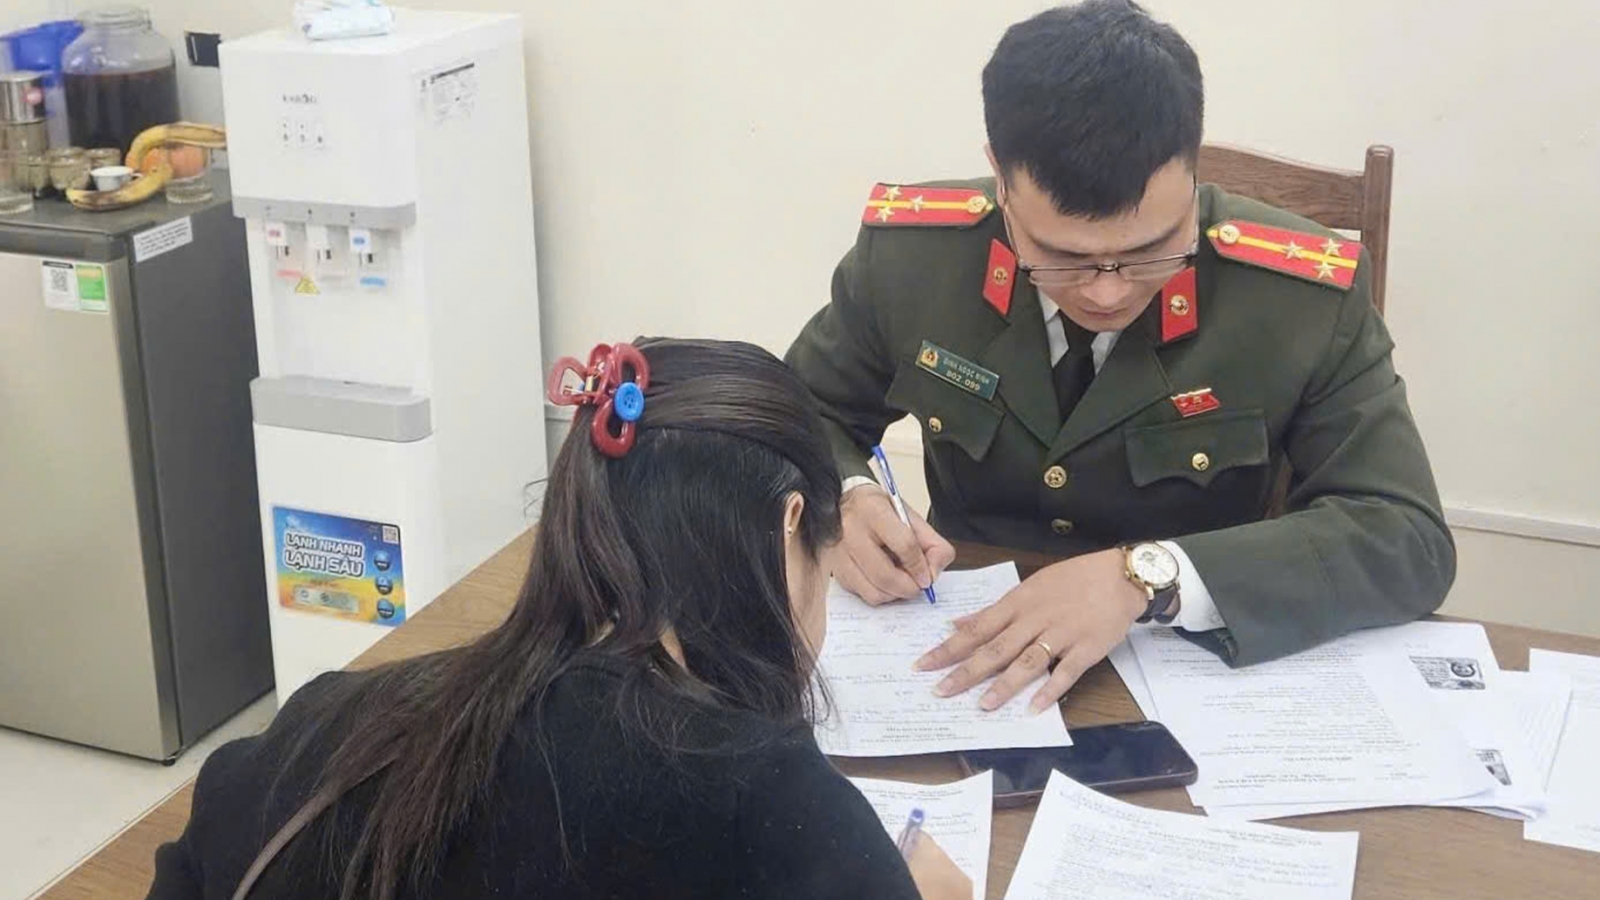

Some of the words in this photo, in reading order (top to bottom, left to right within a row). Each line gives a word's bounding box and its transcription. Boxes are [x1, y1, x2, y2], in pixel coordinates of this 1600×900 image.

[285, 533, 317, 551] LẠNH
[318, 540, 363, 559] NHANH
[284, 549, 327, 571] LẠNH
[328, 554, 364, 577] SÂU
